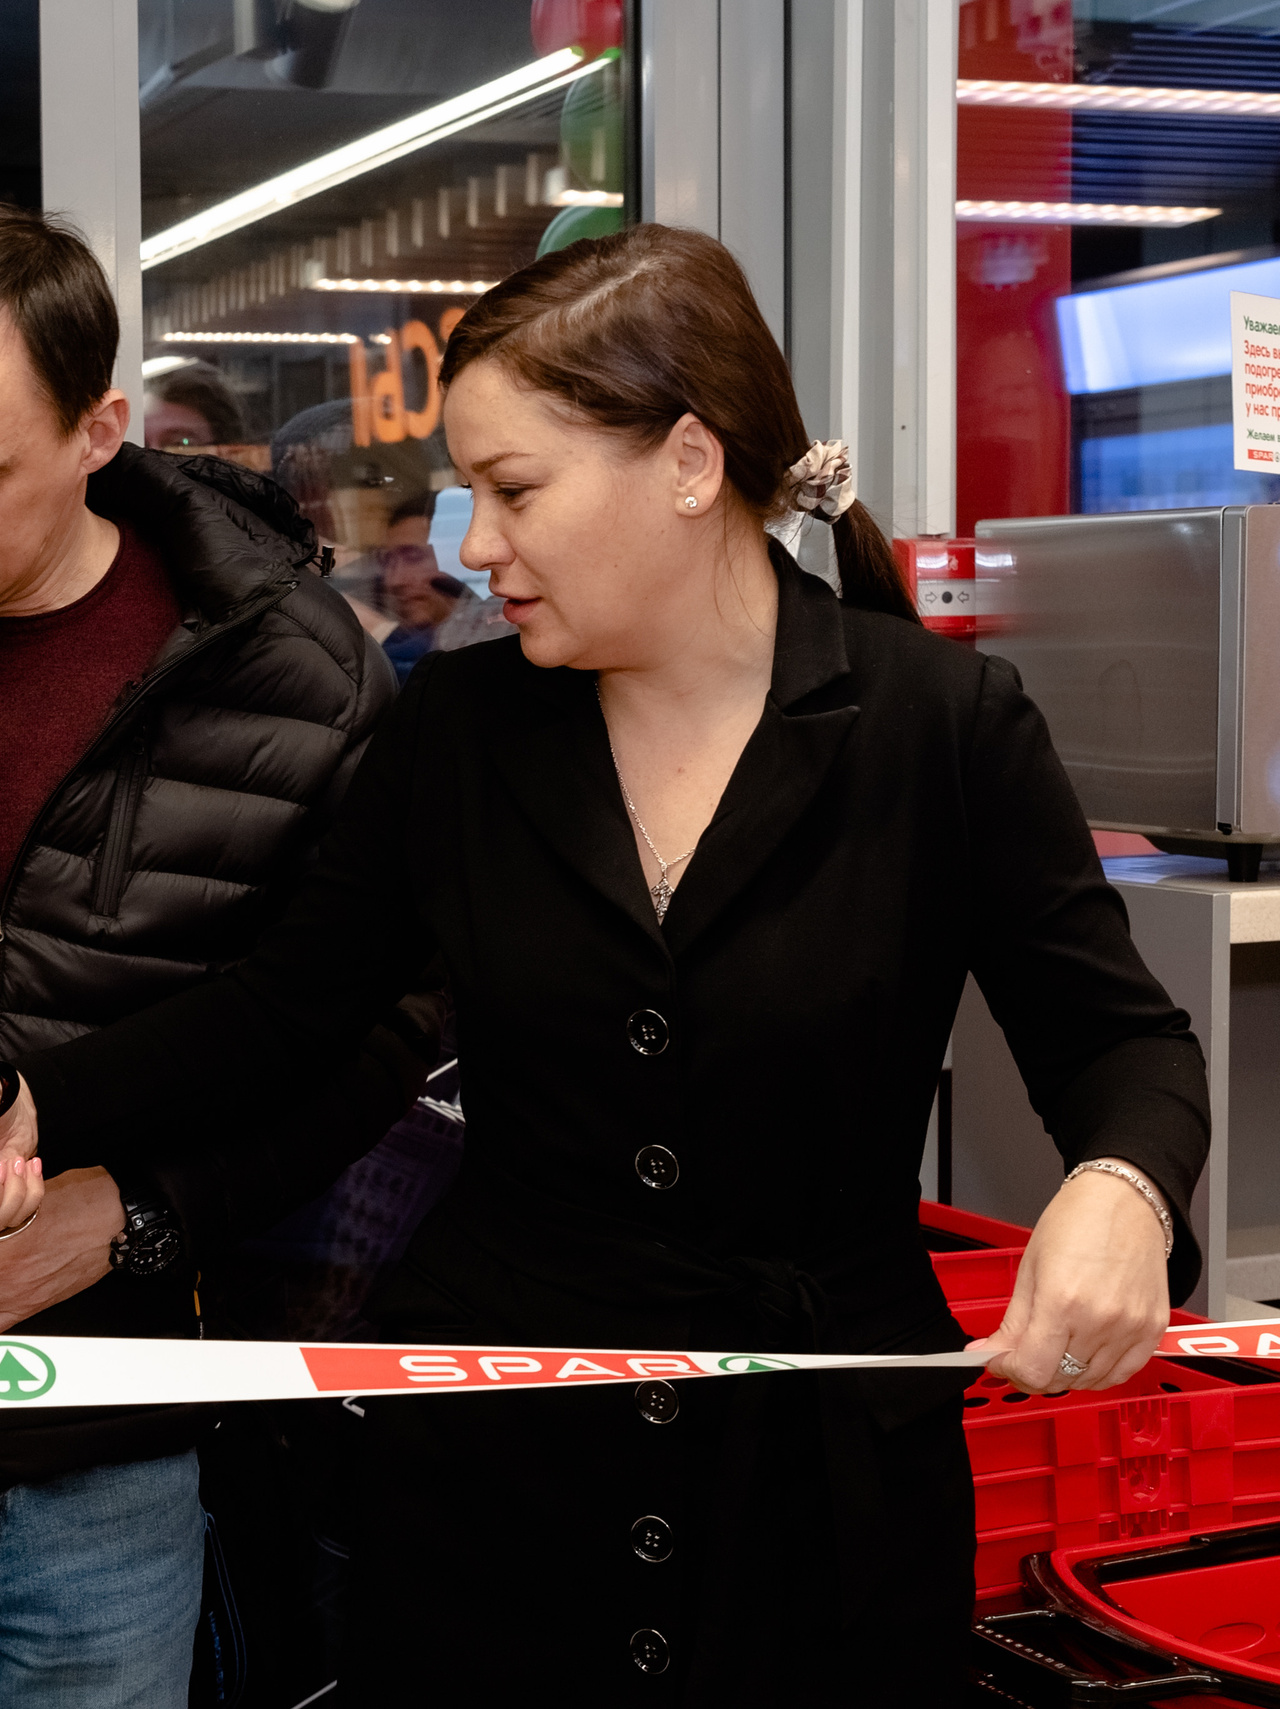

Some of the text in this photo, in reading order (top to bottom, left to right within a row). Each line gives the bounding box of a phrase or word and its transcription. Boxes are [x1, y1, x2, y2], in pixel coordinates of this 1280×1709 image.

[1243, 315, 1280, 336] Уважае
[1244, 339, 1271, 359] Здесь
[1245, 382, 1280, 401] приобр
[1245, 402, 1252, 418] у
[1253, 403, 1269, 416] нас
[1247, 428, 1275, 442] Желаем
[1252, 450, 1273, 460] SPAR
[399, 1355, 700, 1382] SPAR
